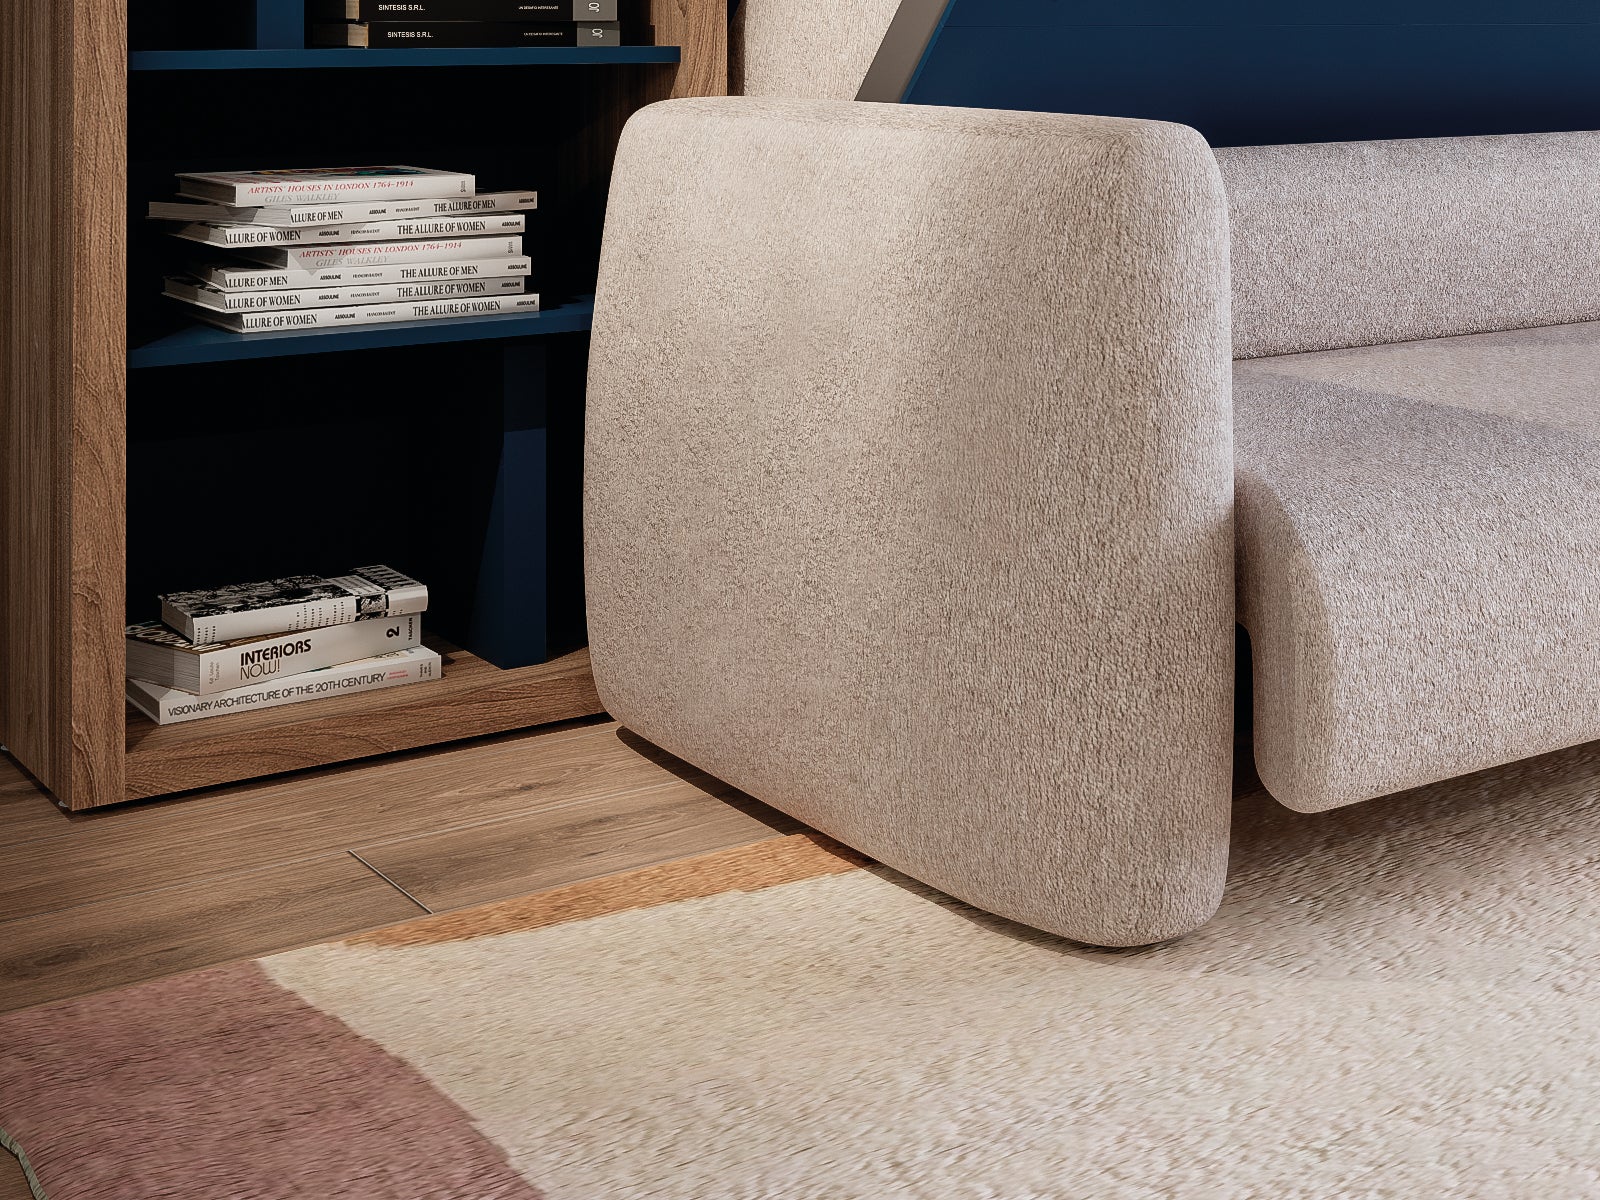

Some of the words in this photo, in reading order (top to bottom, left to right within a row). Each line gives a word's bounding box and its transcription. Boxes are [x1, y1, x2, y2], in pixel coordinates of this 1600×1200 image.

[288, 184, 321, 192] HOUSES
[335, 182, 370, 190] LONDON
[264, 194, 293, 203] GILES
[296, 193, 340, 201] WALKLEY
[434, 203, 447, 212] THE
[449, 201, 472, 211] ALLURE
[473, 200, 481, 209] OF
[481, 199, 496, 209] MEN
[317, 212, 327, 221] OF
[327, 210, 343, 220] MEN
[397, 225, 413, 235] THE
[415, 223, 444, 234] ALLURE
[445, 222, 456, 232] OF
[456, 221, 486, 231] WOMEN
[257, 232, 268, 242] OF
[269, 230, 301, 242] WOMEN
[338, 248, 372, 256] HOUSES
[385, 245, 419, 253] LONDON
[316, 259, 343, 267] GILES
[346, 256, 389, 264] WALKLEY
[400, 269, 417, 278] THE
[418, 267, 448, 278] ALLURE
[450, 266, 460, 276] OF
[461, 265, 478, 275] MEN
[257, 276, 269, 286] OF
[270, 276, 288, 286] MEN
[397, 287, 413, 297] THE
[414, 285, 444, 296] ALLURE
[445, 284, 456, 294] OF
[456, 282, 486, 293] WOMEN
[256, 297, 268, 307] OF
[269, 294, 301, 306] WOMEN
[413, 306, 429, 316] THE
[430, 304, 459, 315] ALLURE
[460, 303, 471, 313] OF
[471, 301, 501, 312] WOMEN
[273, 317, 284, 327] OF
[286, 314, 318, 326] WOMEN
[386, 626, 400, 638] 2
[240, 638, 312, 667] INTERIORS
[240, 659, 281, 680] NOW!
[168, 701, 213, 716] VISIONARY
[213, 690, 281, 709] ARCHITECTURE
[282, 686, 296, 698] OF
[296, 684, 314, 695] THE
[315, 680, 340, 692] 20TH
[342, 672, 386, 688] CENTURY
